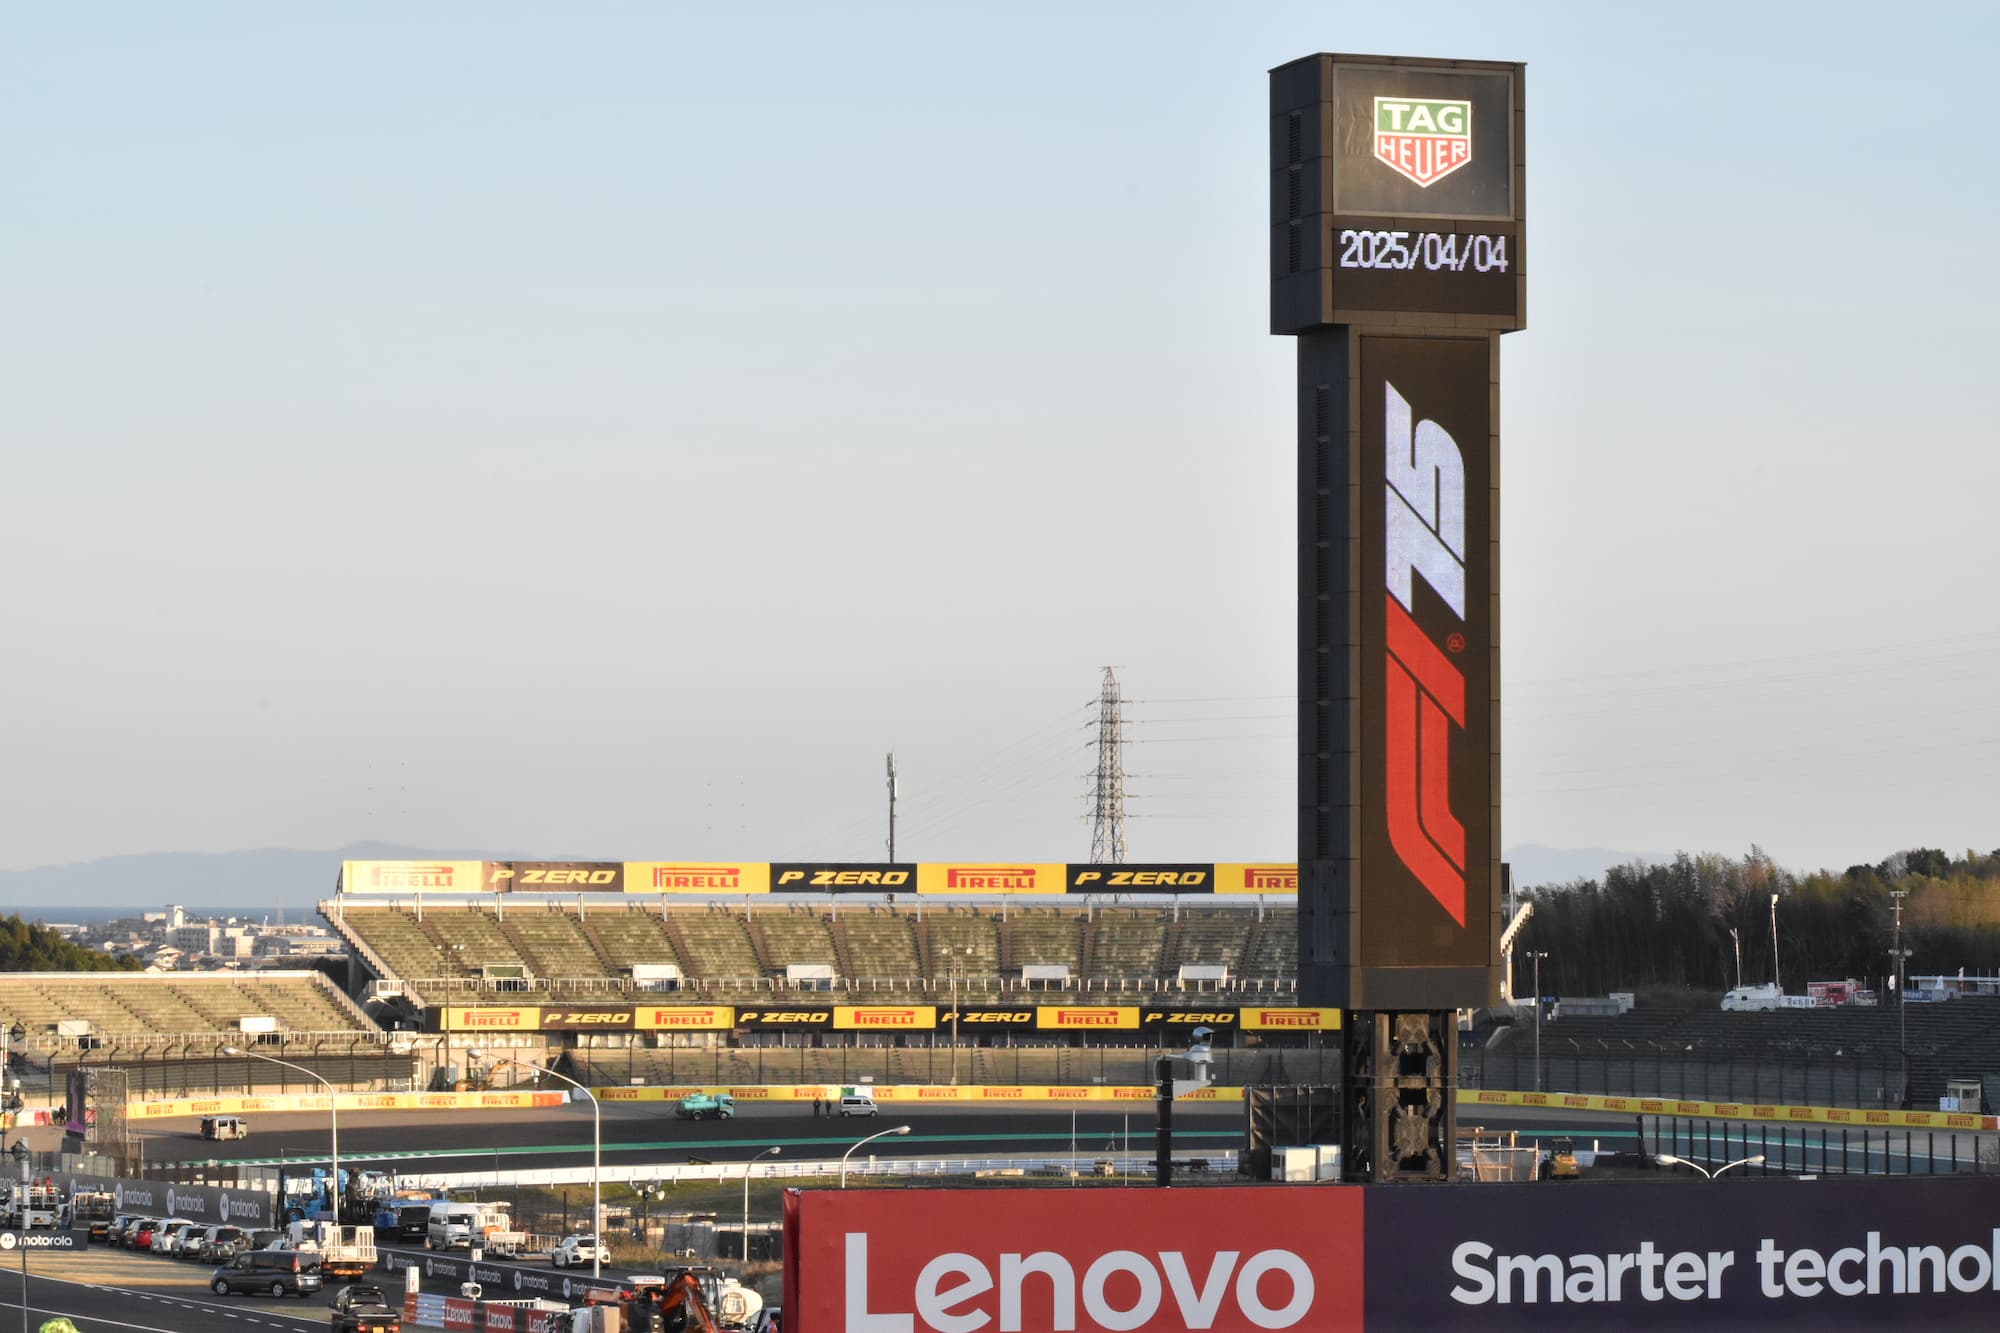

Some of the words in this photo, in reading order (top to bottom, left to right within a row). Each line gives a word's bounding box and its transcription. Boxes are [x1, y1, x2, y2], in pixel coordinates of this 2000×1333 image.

[1382, 104, 1463, 133] TAG
[1380, 137, 1466, 180] HEUER
[1340, 230, 1509, 273] 2025/04/04
[489, 870, 516, 884] P
[519, 870, 617, 884] ZERO
[653, 867, 741, 888] PIRELLI
[777, 871, 804, 885] P
[809, 871, 909, 885] ZERO
[947, 868, 1036, 888] PIRELLI
[1075, 871, 1102, 886] P
[1106, 871, 1207, 886] ZERO
[464, 1011, 520, 1026] PIRELLI
[544, 1013, 562, 1023] P
[565, 1013, 631, 1023] ZERO
[655, 1011, 714, 1025] PIRELLI
[739, 1012, 758, 1023] P
[761, 1012, 829, 1023] ZERO
[854, 1010, 915, 1024] PIRELLI
[963, 1012, 1031, 1023] ZERO
[1057, 1010, 1119, 1025] PIRELLI
[1144, 1012, 1163, 1023] P
[1167, 1012, 1235, 1023] ZERO
[1260, 1011, 1320, 1026] PIRELLI
[18, 1235, 73, 1247] motorola
[1449, 1241, 1735, 1306] Smarter
[845, 1232, 1315, 1333] Lenovo
[446, 1304, 472, 1324] Lenovo
[487, 1309, 512, 1330] Lenovo
